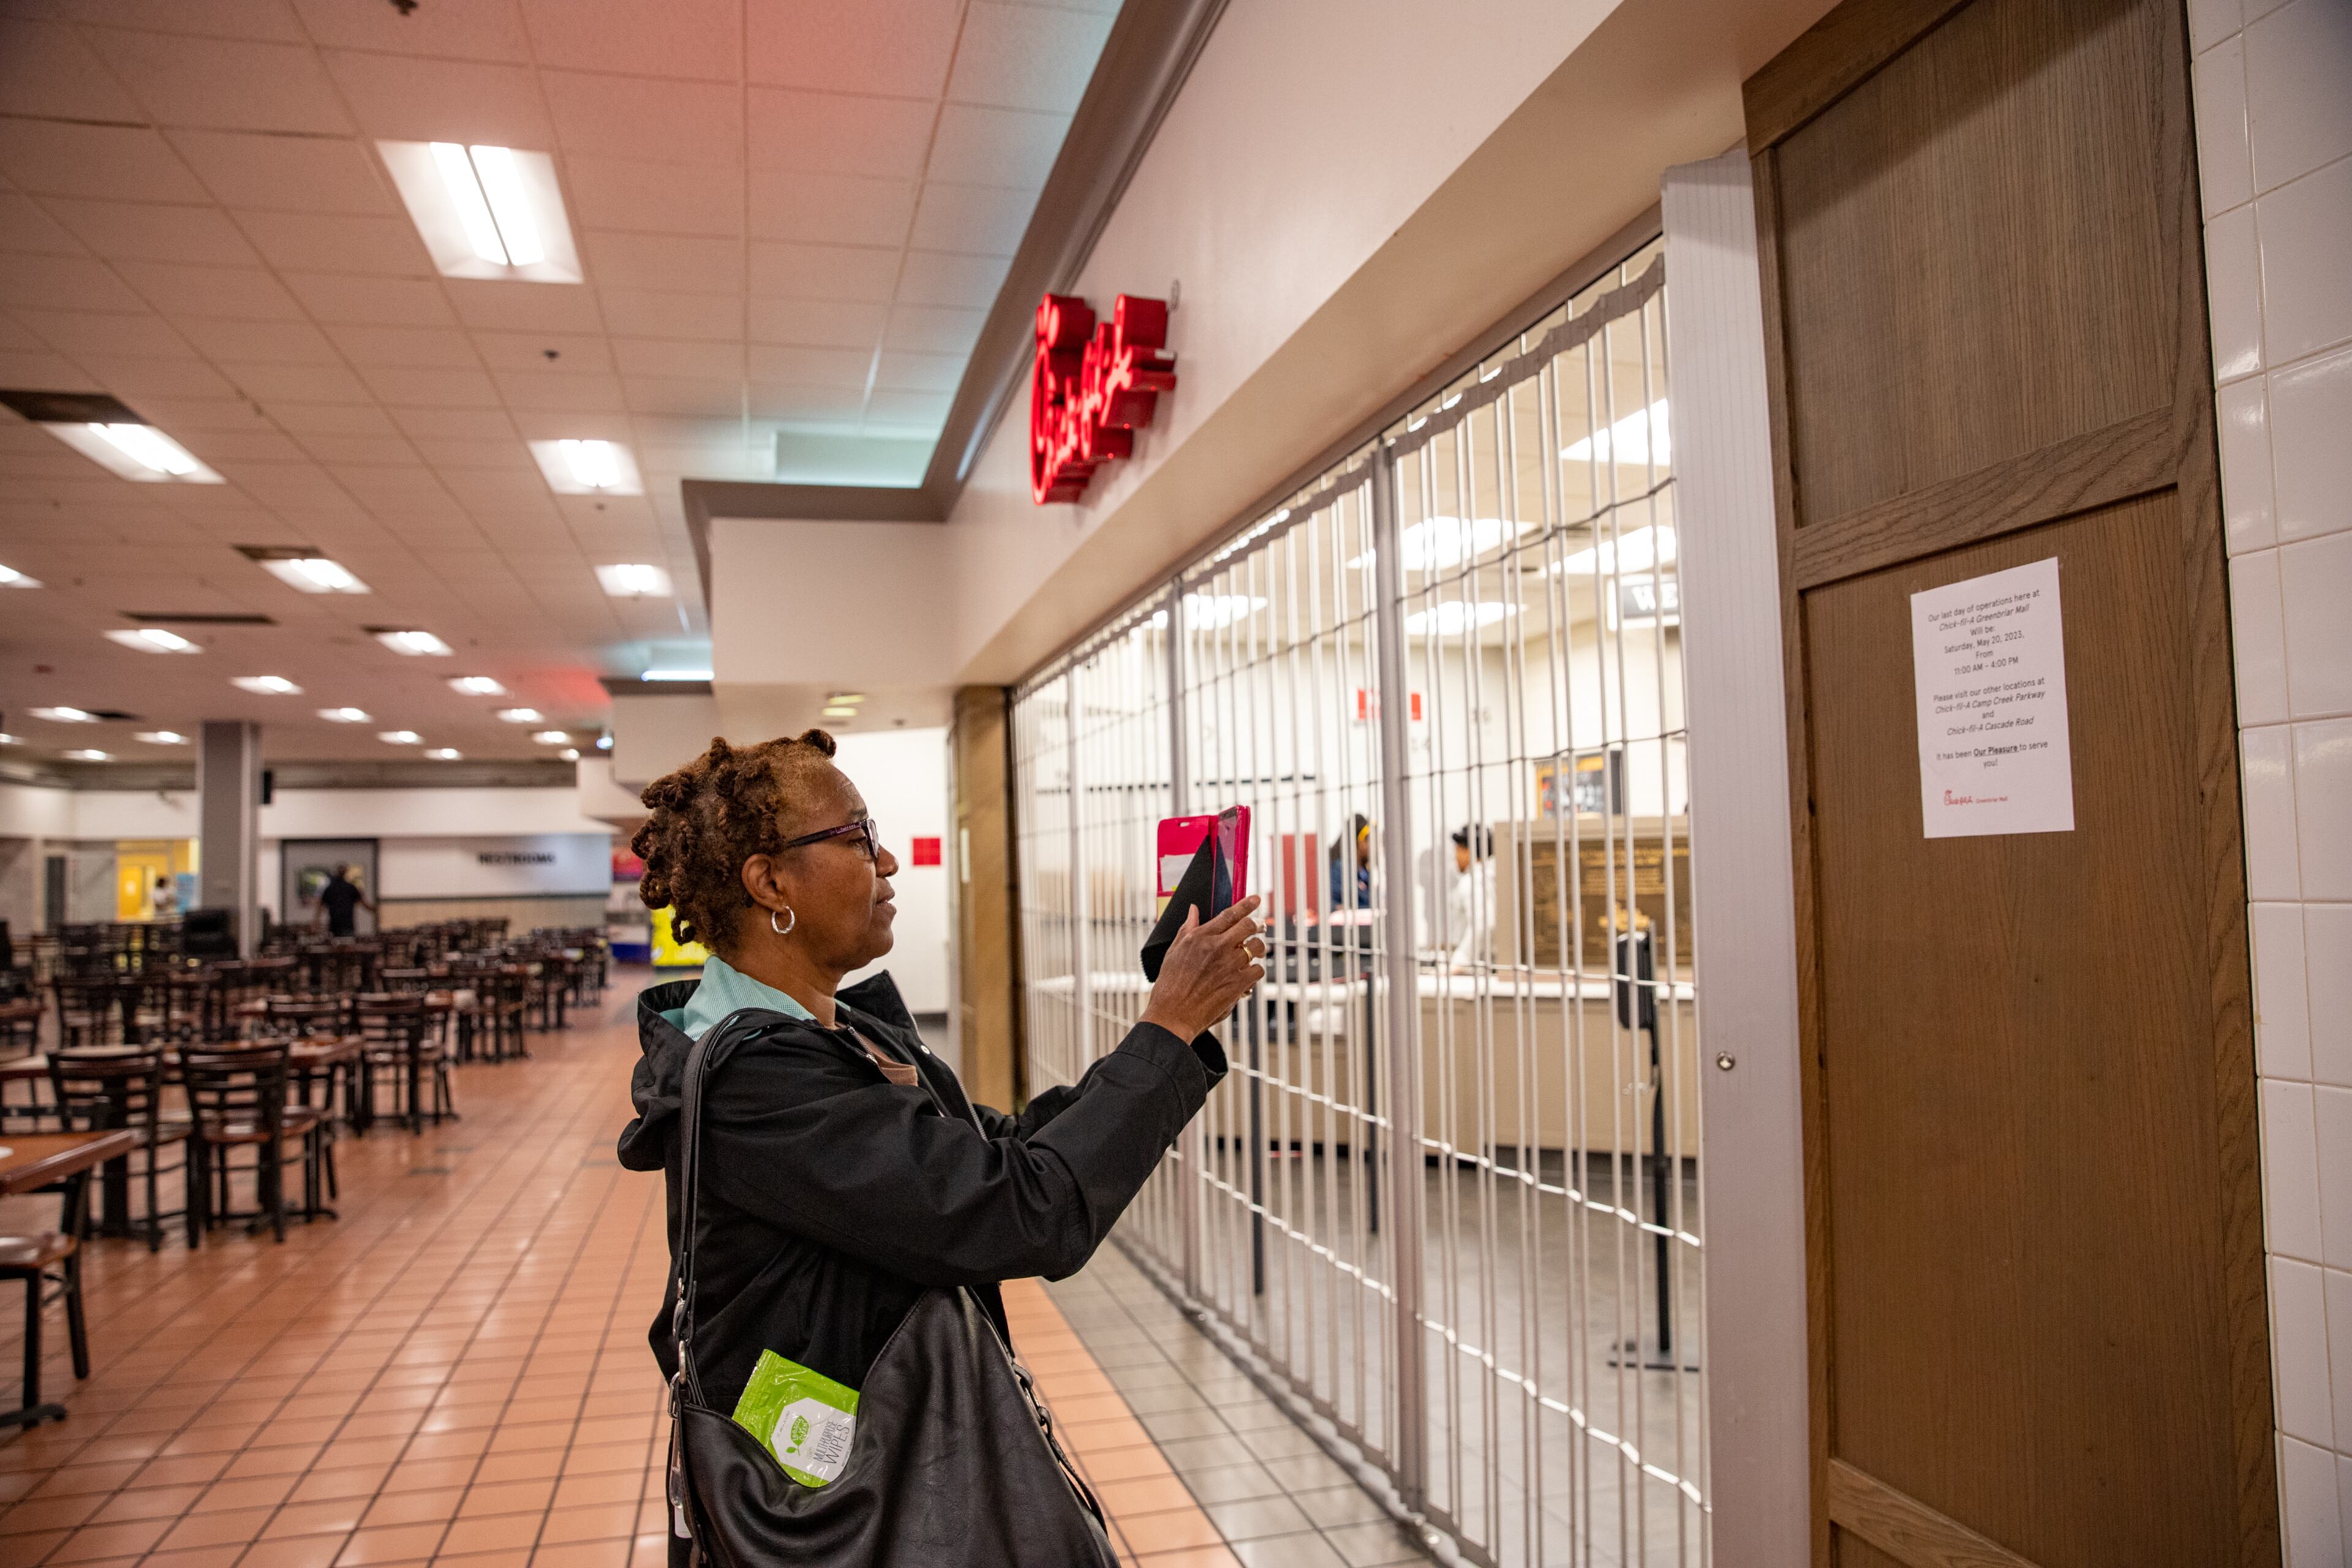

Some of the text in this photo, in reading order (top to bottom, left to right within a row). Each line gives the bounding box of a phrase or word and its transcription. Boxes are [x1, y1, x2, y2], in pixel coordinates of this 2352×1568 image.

[1928, 614, 1940, 622] Our
[1941, 611, 1952, 619] last
[1967, 605, 1974, 613] of
[1975, 597, 2013, 611] operations
[2014, 592, 2030, 601] here
[2032, 589, 2040, 598] at
[1939, 603, 2030, 631] Chick-fil-A Greenbriar Mall
[1970, 625, 1996, 636] Will be:
[1944, 643, 1975, 654] Saturday,
[1977, 638, 1989, 647] May
[1991, 635, 2003, 644] 20,
[1975, 650, 1993, 659] From
[1954, 665, 1971, 675] 11:00
[1972, 663, 1983, 672] AM
[1991, 659, 2007, 668] 4:00
[2008, 656, 2019, 665] PM
[1934, 693, 1953, 702] Please
[1954, 690, 1968, 699] visit
[1983, 685, 2001, 695] other
[2003, 680, 2035, 691] locations
[1935, 690, 2046, 714] Chick-fil-A Camp Creek Parkway
[1981, 710, 1994, 719] and
[1947, 716, 2034, 736] Chick-fil-A Cascade Road
[1955, 750, 1972, 758] been
[1973, 748, 1986, 758] Our
[1988, 745, 2018, 755] Pleasure
[2029, 741, 2049, 750] serve
[1983, 758, 1998, 768] you!
[823, 1424, 850, 1464] WIPES
